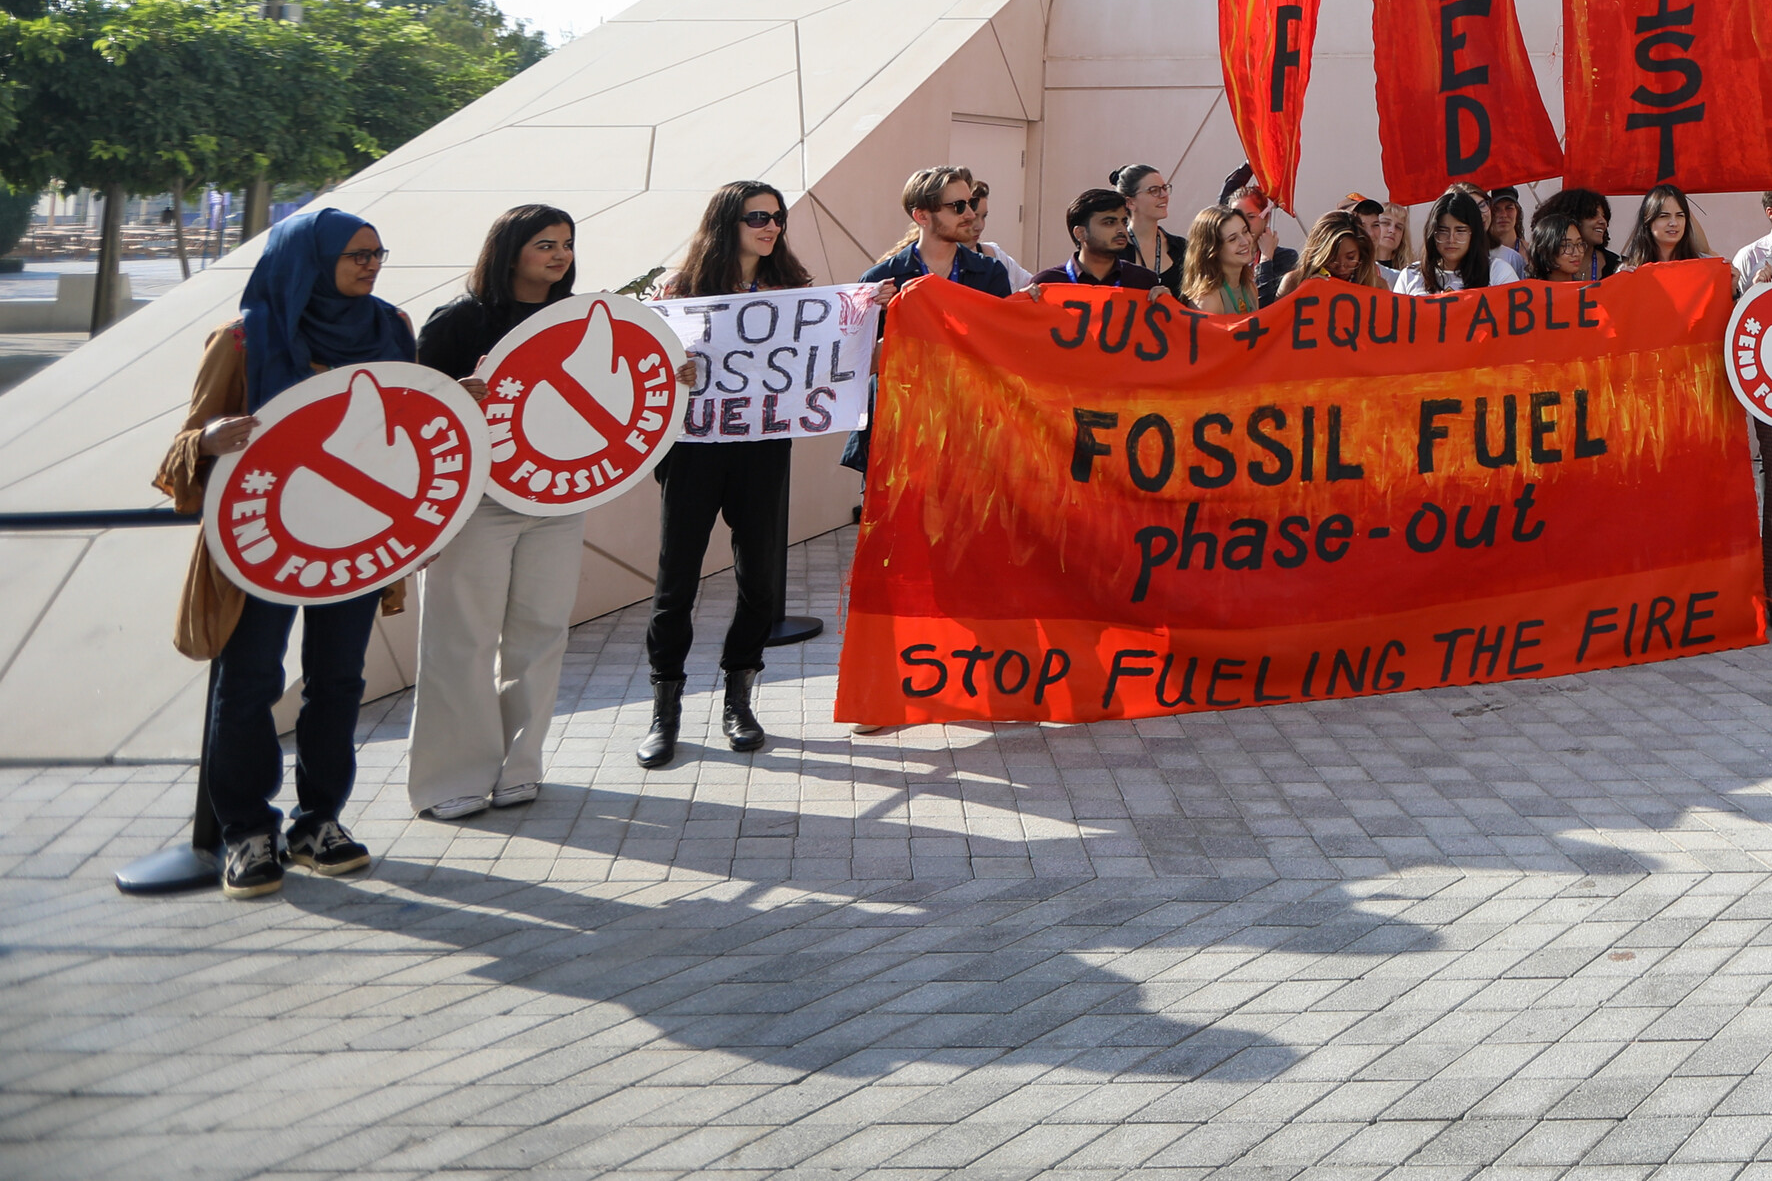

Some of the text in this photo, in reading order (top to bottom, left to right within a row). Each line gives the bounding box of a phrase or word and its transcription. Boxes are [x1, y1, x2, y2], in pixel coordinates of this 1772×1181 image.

[650, 298, 832, 344] TOP
[688, 339, 855, 396] OSSIL
[1050, 299, 1211, 365] JUST
[1292, 280, 1602, 352] EQUITABLE
[1738, 317, 1762, 380] #END
[486, 352, 669, 496] #END FOSSIL FUELS
[684, 387, 837, 437] UELS
[1070, 389, 1607, 493] FOSSIL FUEL
[232, 416, 463, 588] #END FOSSIL FUELS
[1130, 483, 1546, 603] phase-out
[901, 591, 1719, 709] STOP FUELING THE FIRE
